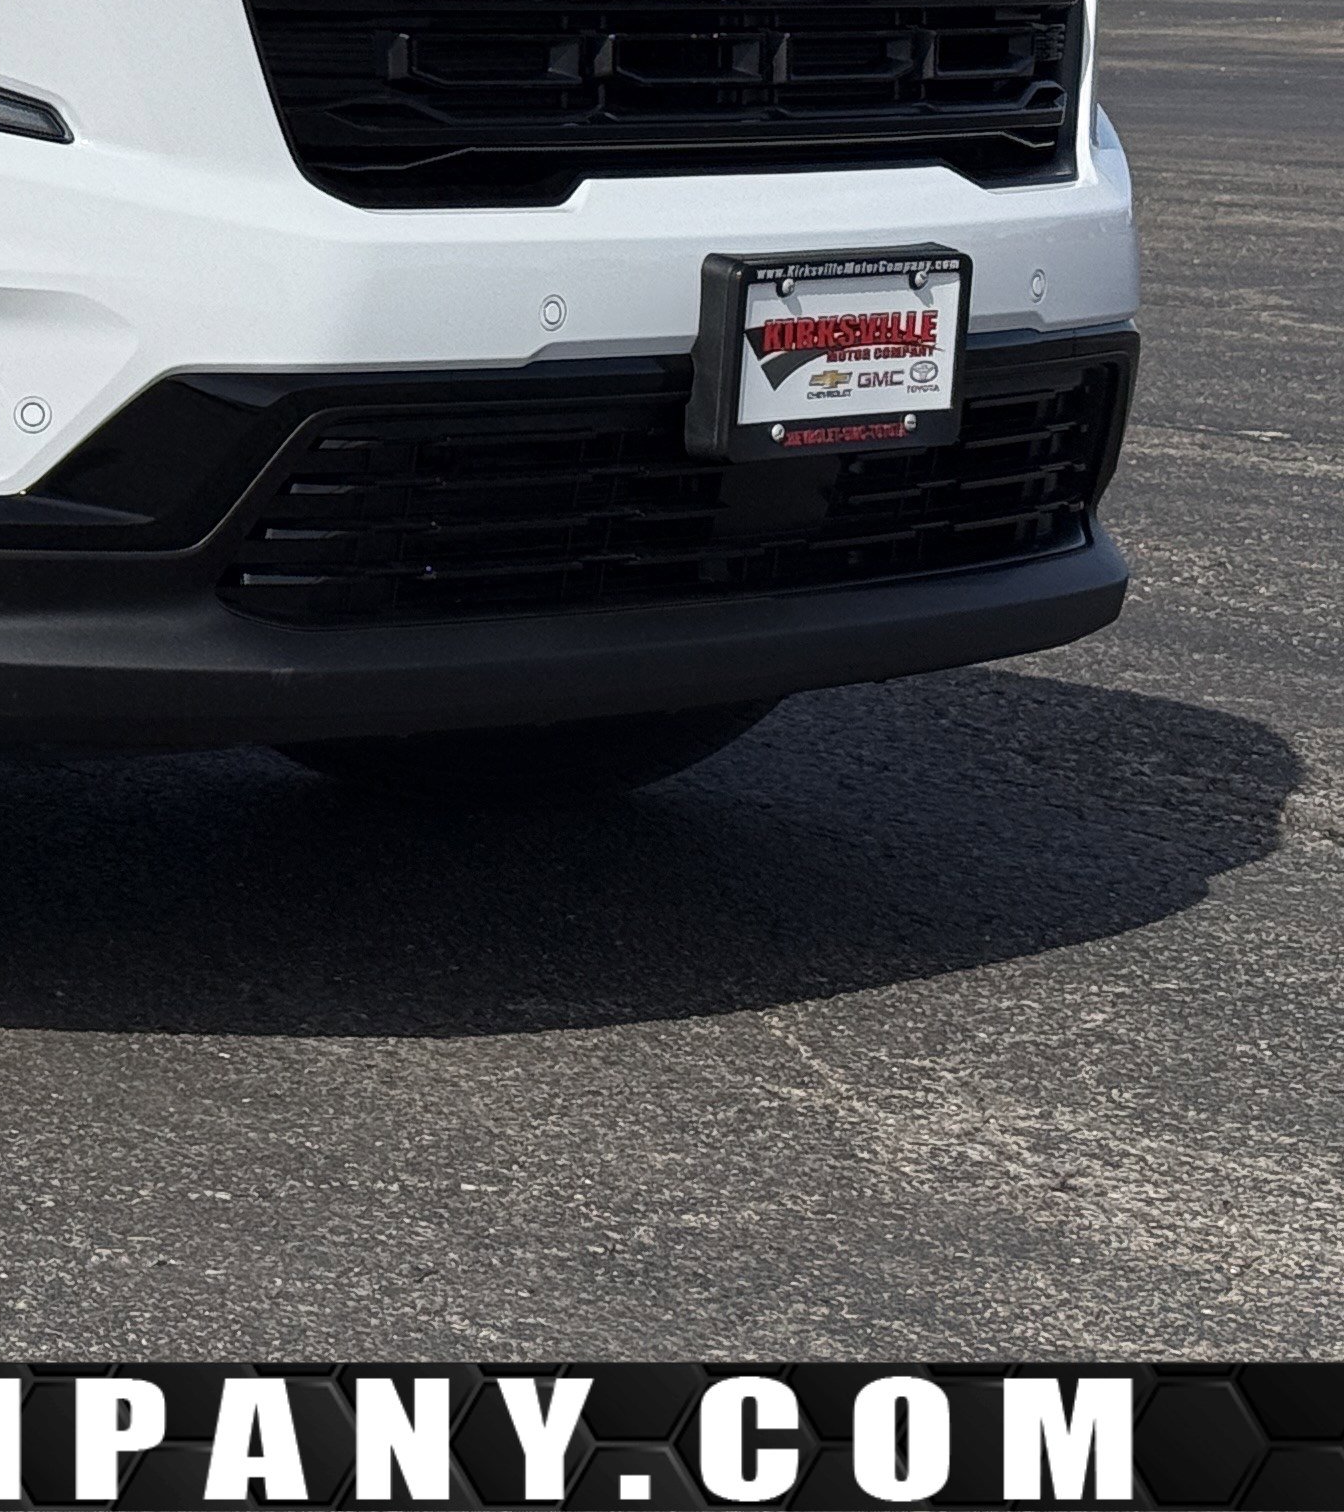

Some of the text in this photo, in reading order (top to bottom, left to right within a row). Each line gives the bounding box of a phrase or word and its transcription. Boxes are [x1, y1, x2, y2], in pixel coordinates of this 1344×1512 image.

[755, 258, 961, 281] www.KirksvilleMotorCompany.com
[762, 309, 939, 354] KIRKSVILLE
[825, 343, 937, 364] MOTOR COMPANY
[857, 370, 906, 388] GMC
[806, 388, 853, 400] CHEVROLET
[906, 384, 941, 394] TOYOTA
